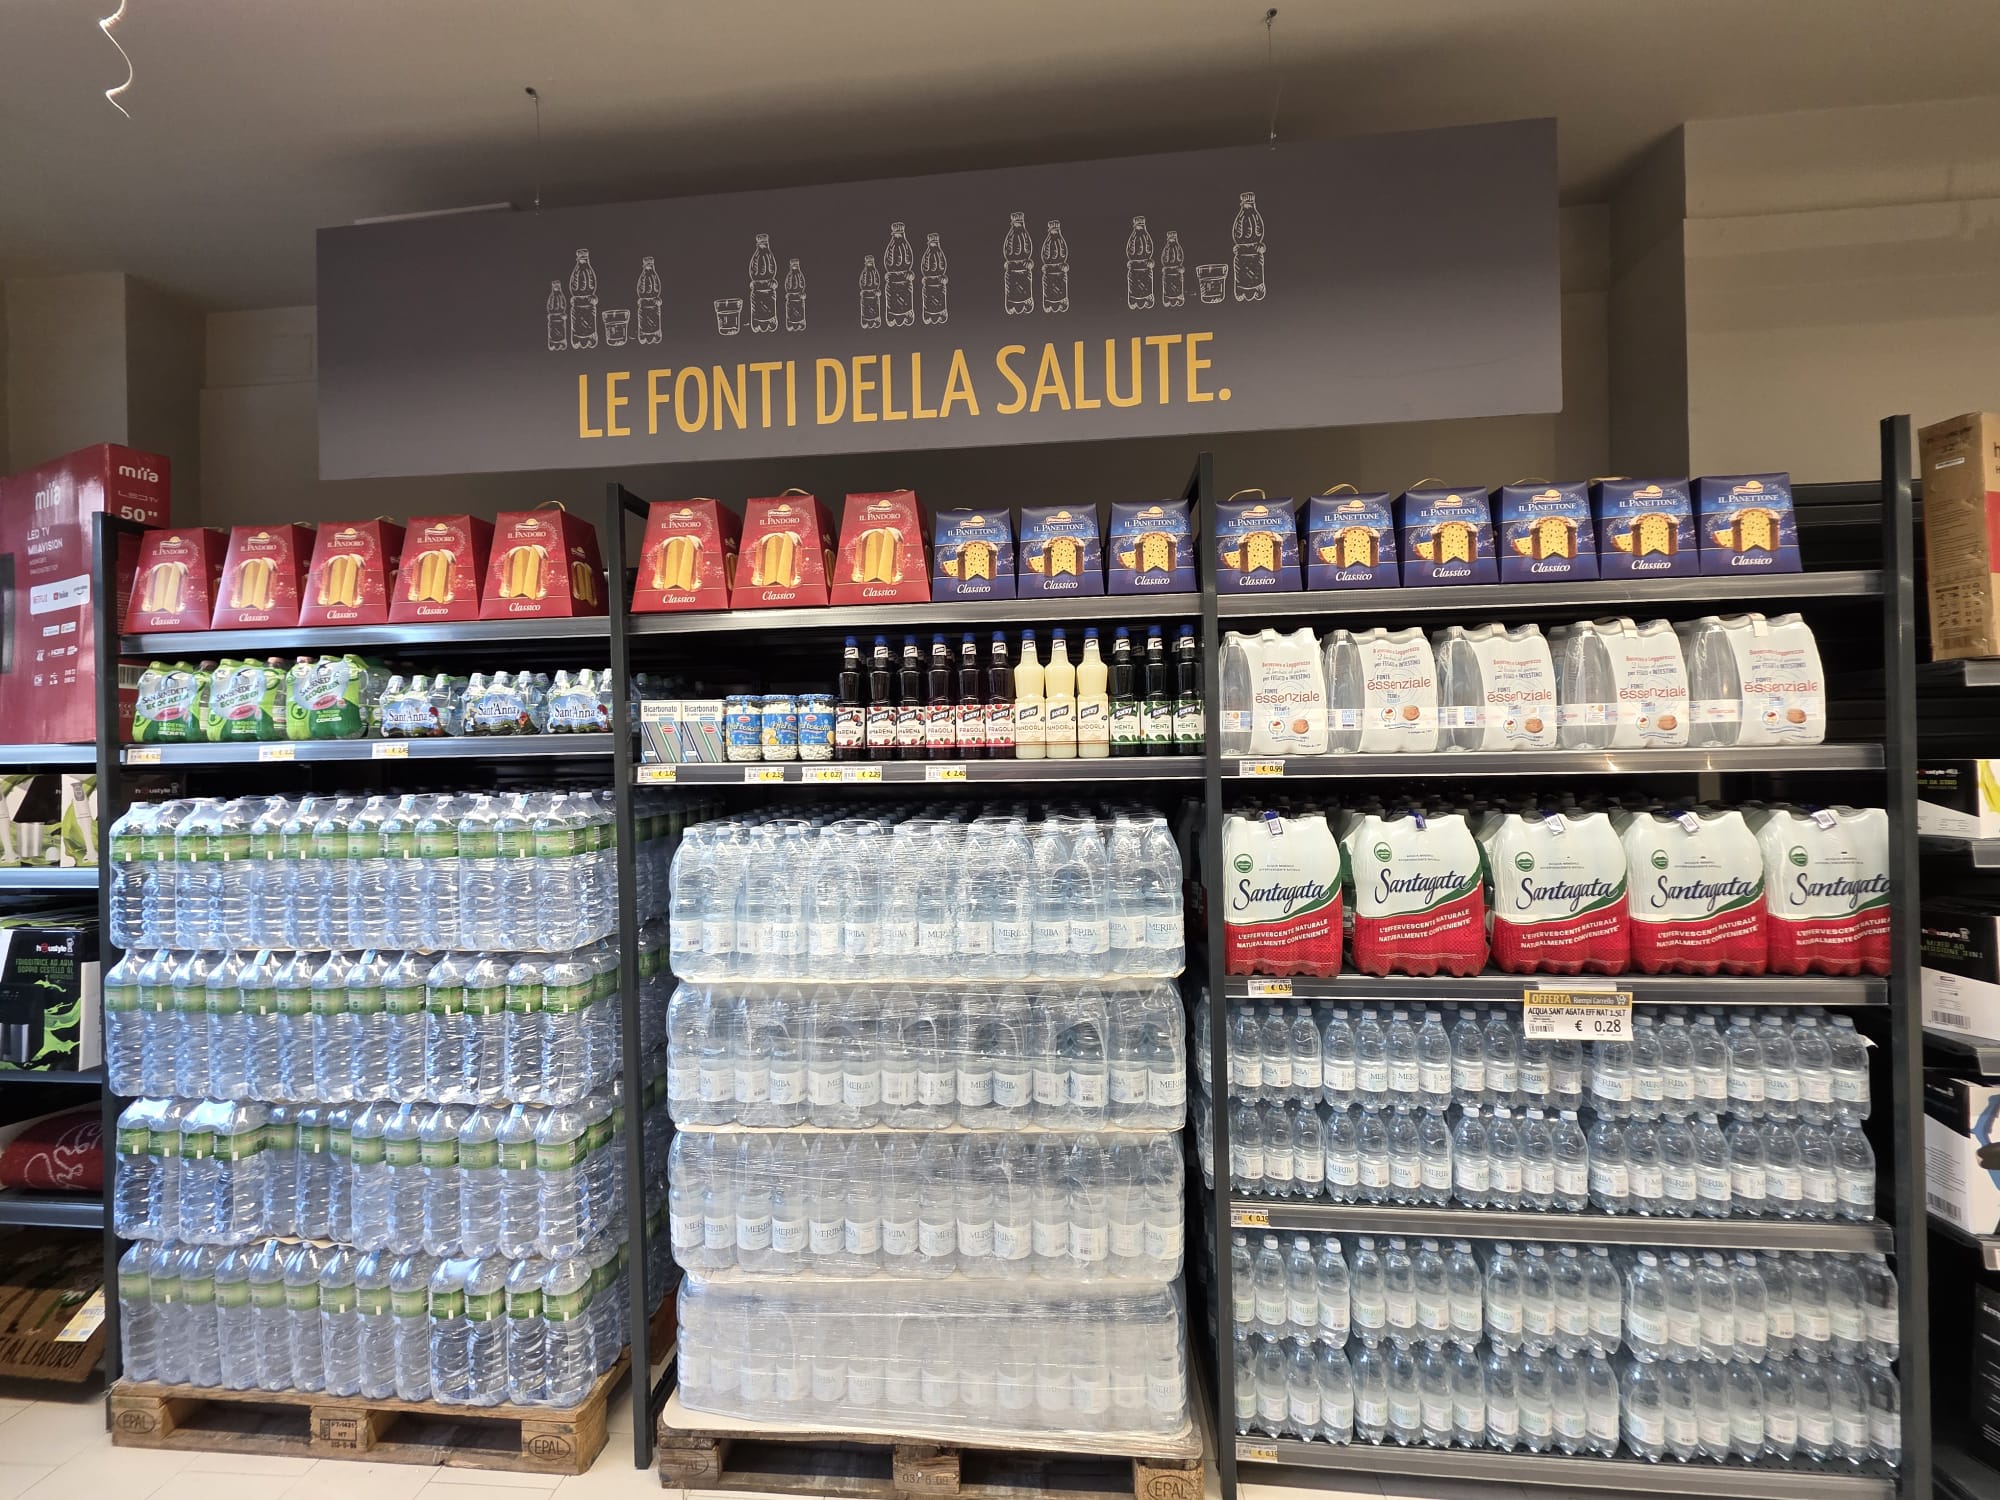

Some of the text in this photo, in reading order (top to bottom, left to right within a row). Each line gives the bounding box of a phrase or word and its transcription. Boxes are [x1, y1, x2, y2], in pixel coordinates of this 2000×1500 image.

[579, 332, 1232, 438] LE FONTI DELLA SALUTE.
[1628, 498, 1678, 507] PANETTONE
[1726, 493, 1779, 503] PANETTONE
[1429, 507, 1477, 516] PANETTONE
[1528, 502, 1577, 512] PANETTONE
[121, 506, 158, 522] 50"
[867, 512, 901, 521] PANDORO
[1333, 512, 1379, 522] PANETTONE
[669, 520, 701, 529] PANDORO
[767, 517, 800, 526] PANDORO
[1042, 522, 1085, 531] PANETTONE
[1133, 518, 1177, 527] PANETTONE
[1237, 517, 1283, 527] PANETTONE
[27, 526, 50, 541] LED TV
[515, 530, 546, 538] PANDORO
[956, 527, 998, 536] PANETTONE
[334, 540, 364, 548] PANDORO
[425, 535, 454, 544] PANDORO
[1631, 559, 1671, 571] Classico
[1731, 555, 1773, 567] Classico
[1432, 566, 1471, 578] Classico
[1531, 562, 1571, 573] Classico
[1134, 575, 1170, 586] Classico
[1239, 575, 1276, 586] Classico
[1335, 570, 1372, 581] Classico
[957, 584, 991, 594] Classico
[1043, 579, 1078, 590] Classico
[762, 591, 795, 601] Classico
[862, 587, 897, 597] Classico
[662, 594, 696, 604] Classico
[416, 606, 448, 615] Classico
[509, 603, 540, 612] Classico
[238, 613, 270, 622] Classico
[326, 610, 358, 619] Classico
[150, 617, 180, 626] Classico
[478, 703, 518, 715] Sant'Anna
[555, 704, 595, 718] Sant'Anna
[388, 711, 428, 723] Sant'Anna
[1374, 868, 1471, 904] Santagata
[1233, 878, 1328, 914] Santagata
[1516, 877, 1619, 912] Santagata
[1651, 874, 1758, 912] Santagata
[1435, 908, 1469, 925] NATURALE
[1295, 918, 1328, 932] NATURALE
[1581, 917, 1618, 932] NATURALE
[1718, 916, 1756, 931] NATURALE
[1378, 929, 1427, 942] NATURALMENTE
[1237, 939, 1286, 948] NATURALMENTE
[1520, 937, 1573, 948] NATURALMENTE
[1656, 938, 1710, 948] NATURALMENTE
[1532, 994, 1572, 1004] OFFERTA
[1573, 997, 1592, 1005] Riempi
[1528, 1008, 1548, 1016] ACQUA
[1574, 1019, 1621, 1032] € 0.28
[123, 1414, 148, 1430] EPAL
[534, 1440, 562, 1456] EPAL
[1156, 1482, 1187, 1499] EPAL
